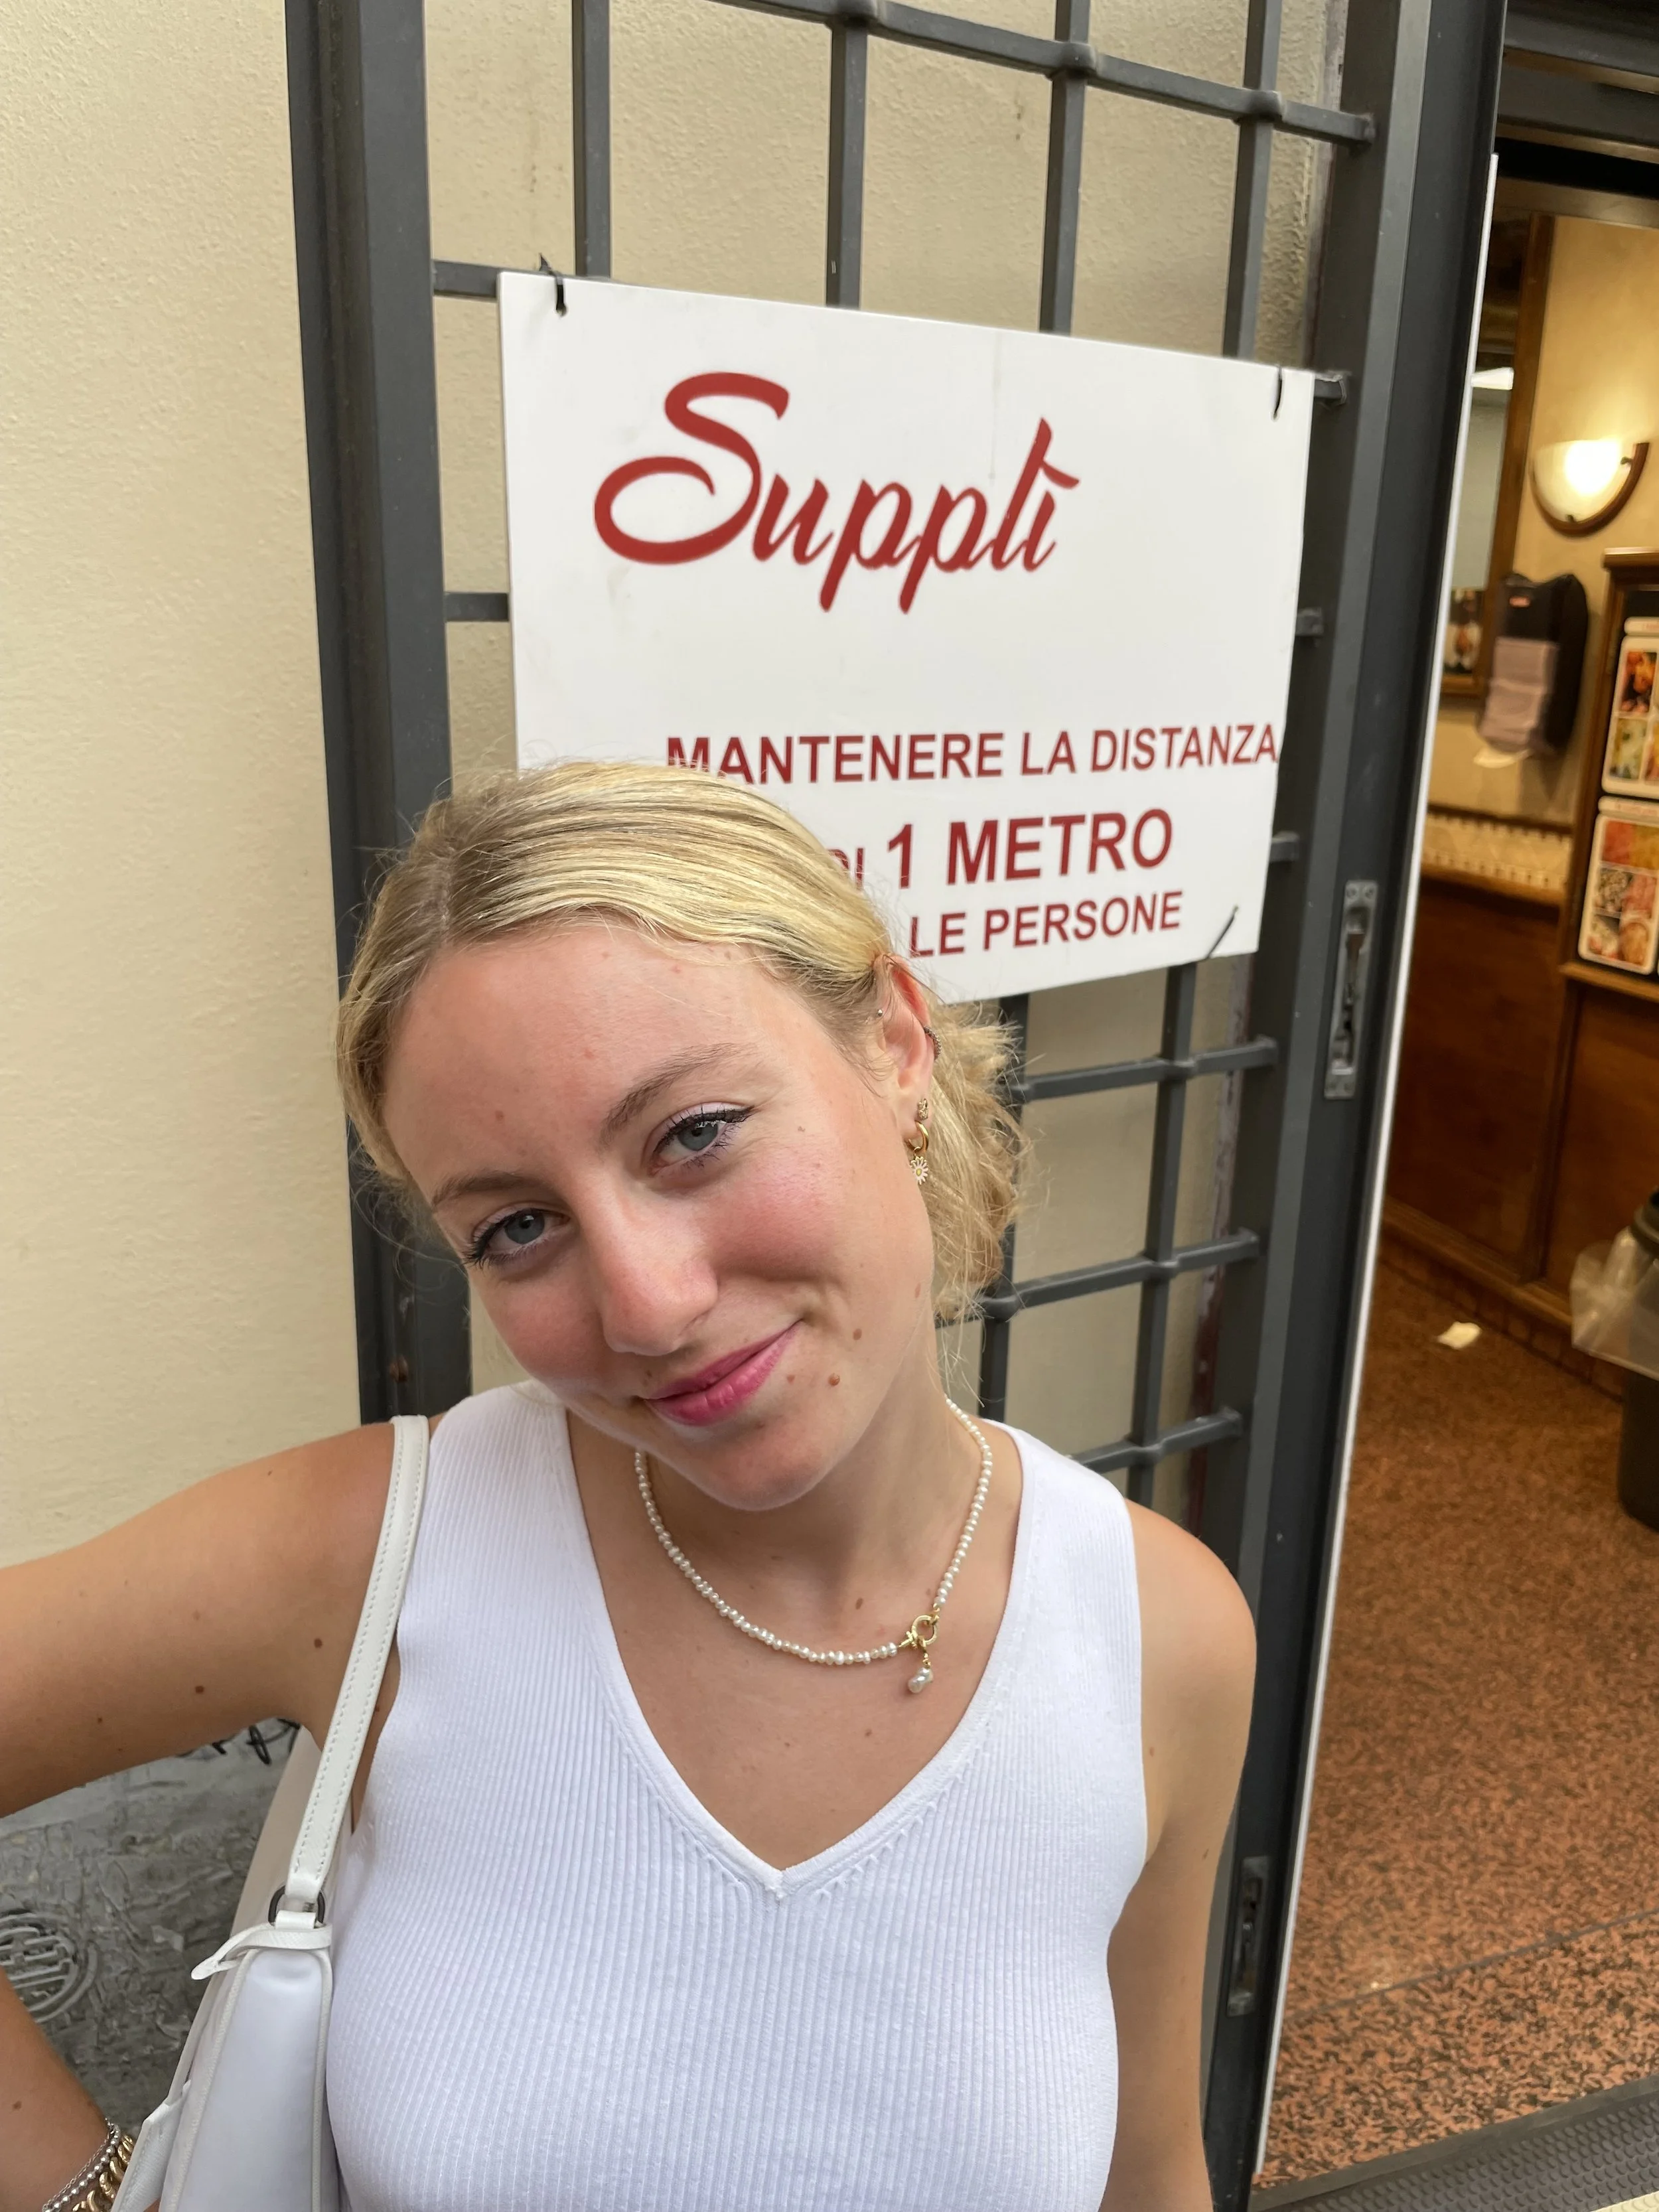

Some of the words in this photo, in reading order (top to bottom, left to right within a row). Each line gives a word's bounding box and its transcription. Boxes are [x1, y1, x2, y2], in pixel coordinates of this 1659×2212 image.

[666, 732, 1004, 785] MANTENERE
[1021, 731, 1076, 776] LA
[1090, 724, 1278, 773] DISTANZA
[887, 822, 912, 889] 1
[946, 808, 1173, 885] METRO
[909, 912, 966, 958] LE
[983, 891, 1182, 950] PERSONE
